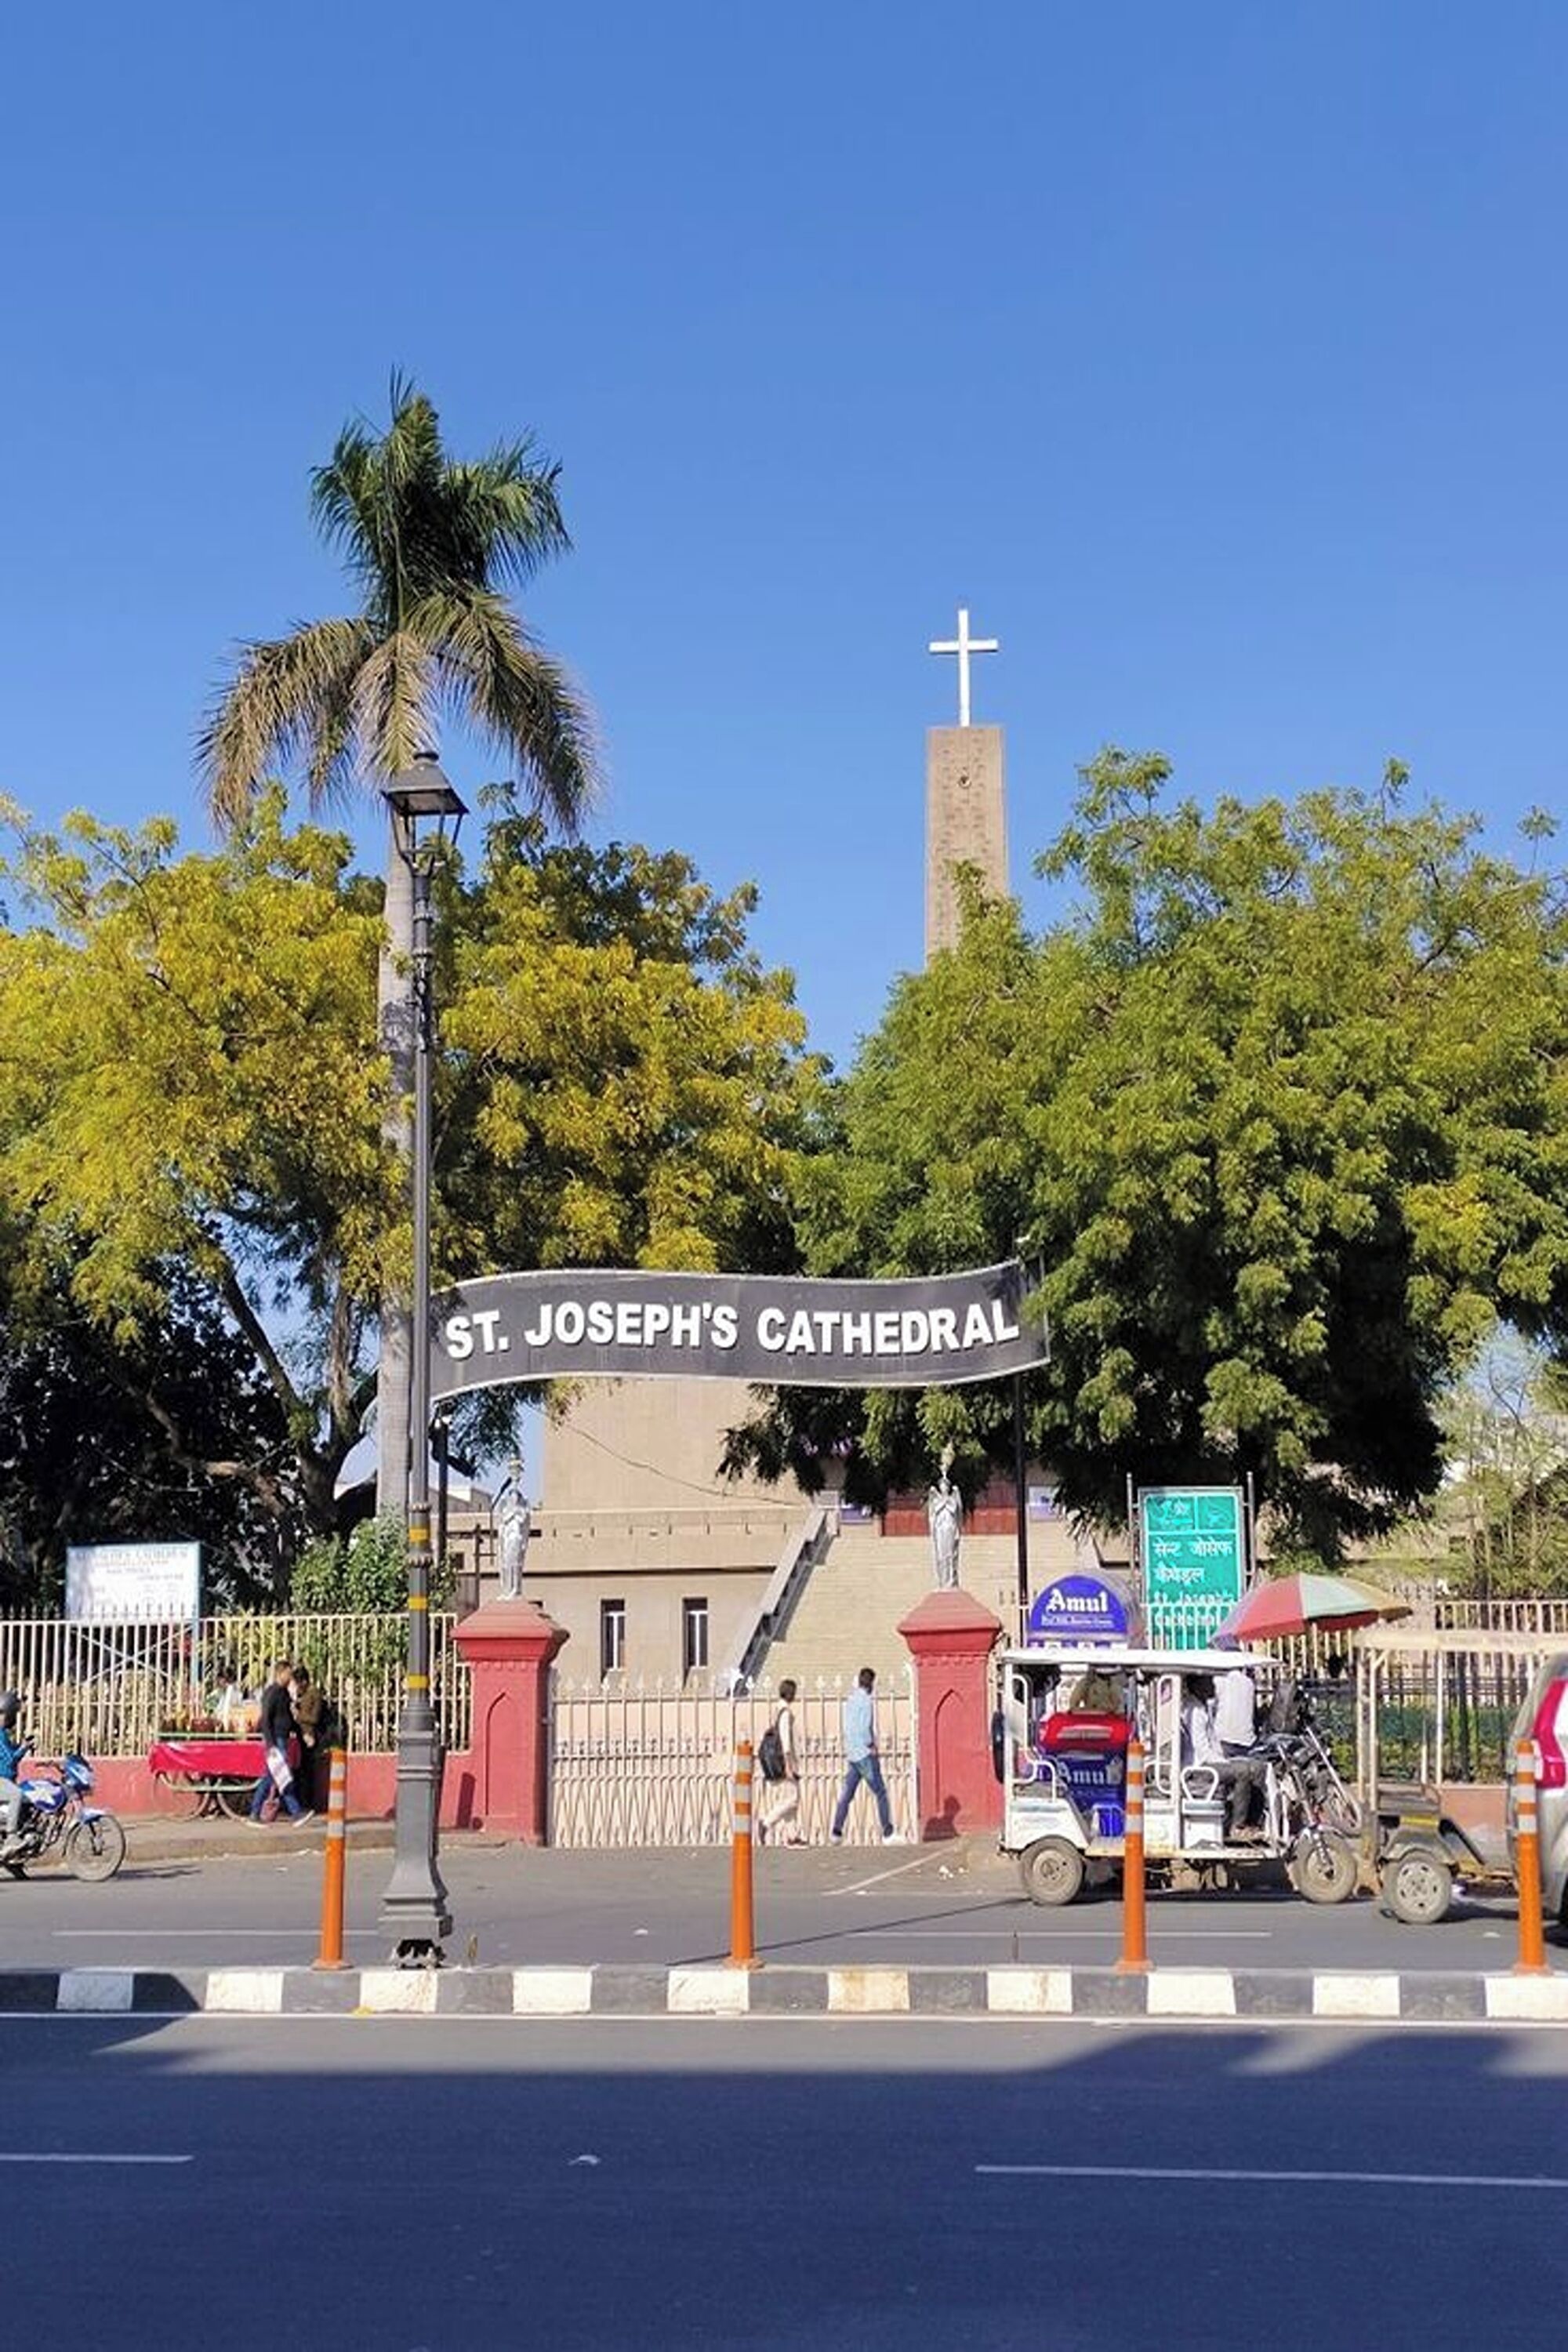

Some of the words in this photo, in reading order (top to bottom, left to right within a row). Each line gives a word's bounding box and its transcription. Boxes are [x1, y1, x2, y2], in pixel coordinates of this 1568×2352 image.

[445, 1310, 510, 1359] ST.
[524, 1301, 739, 1348] JOSEPH'S
[757, 1299, 1020, 1355] CATHEDRAL
[1045, 1588, 1109, 1616] Amul
[1058, 1762, 1108, 1784] Amu
